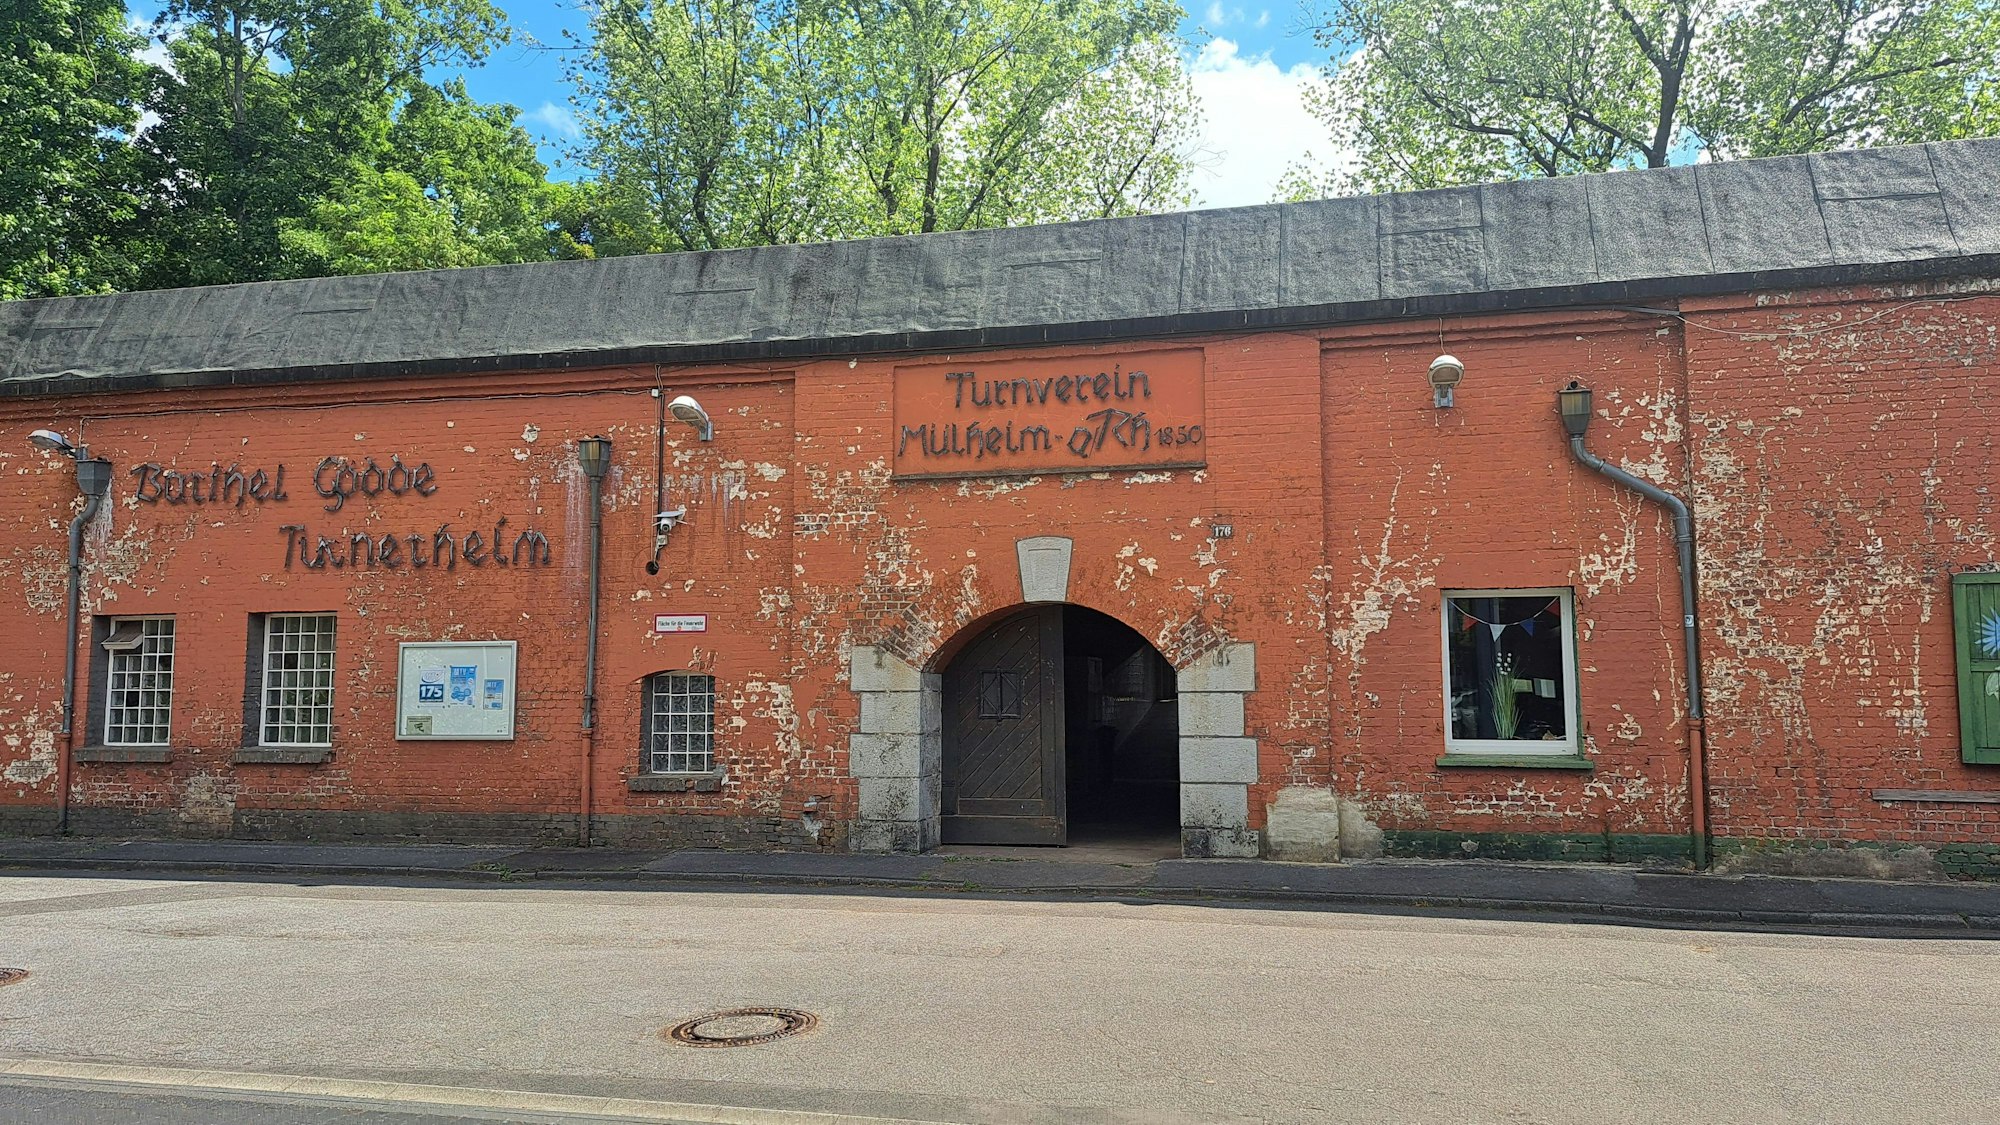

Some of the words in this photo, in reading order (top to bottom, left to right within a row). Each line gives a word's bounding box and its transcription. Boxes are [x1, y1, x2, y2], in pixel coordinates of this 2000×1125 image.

[945, 362, 1151, 409] Turnverein
[1153, 424, 1203, 446] 1850
[130, 462, 288, 507] Barthel
[279, 516, 550, 570] Turnerheim
[1214, 526, 1231, 537] 176
[420, 686, 442, 697] 175
